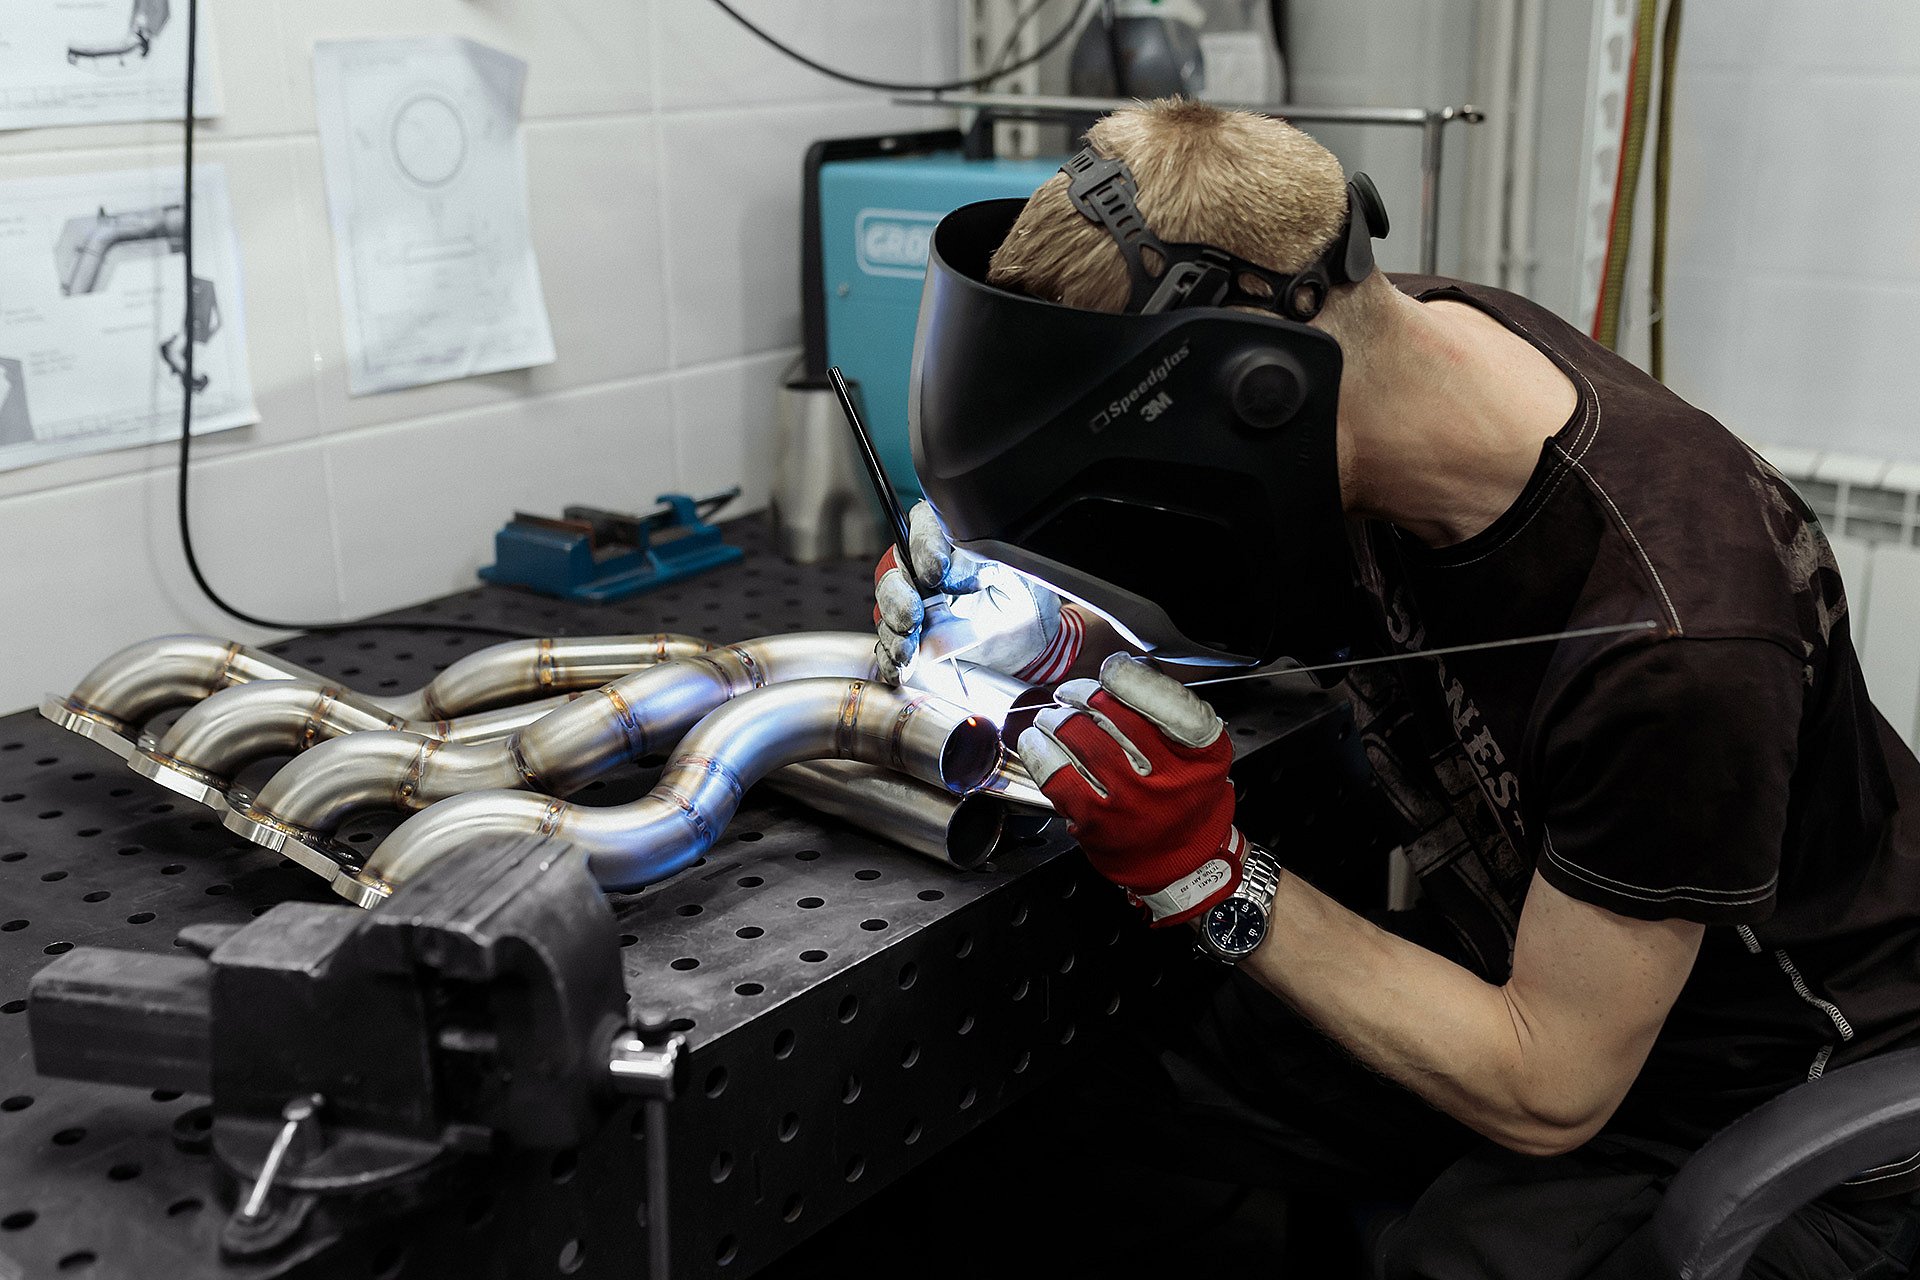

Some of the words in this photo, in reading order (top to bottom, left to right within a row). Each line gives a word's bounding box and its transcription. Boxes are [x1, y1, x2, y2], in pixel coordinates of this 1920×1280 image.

[866, 223, 931, 264] GRO
[1108, 344, 1190, 419] Speedglas
[1140, 391, 1173, 423] 3M
